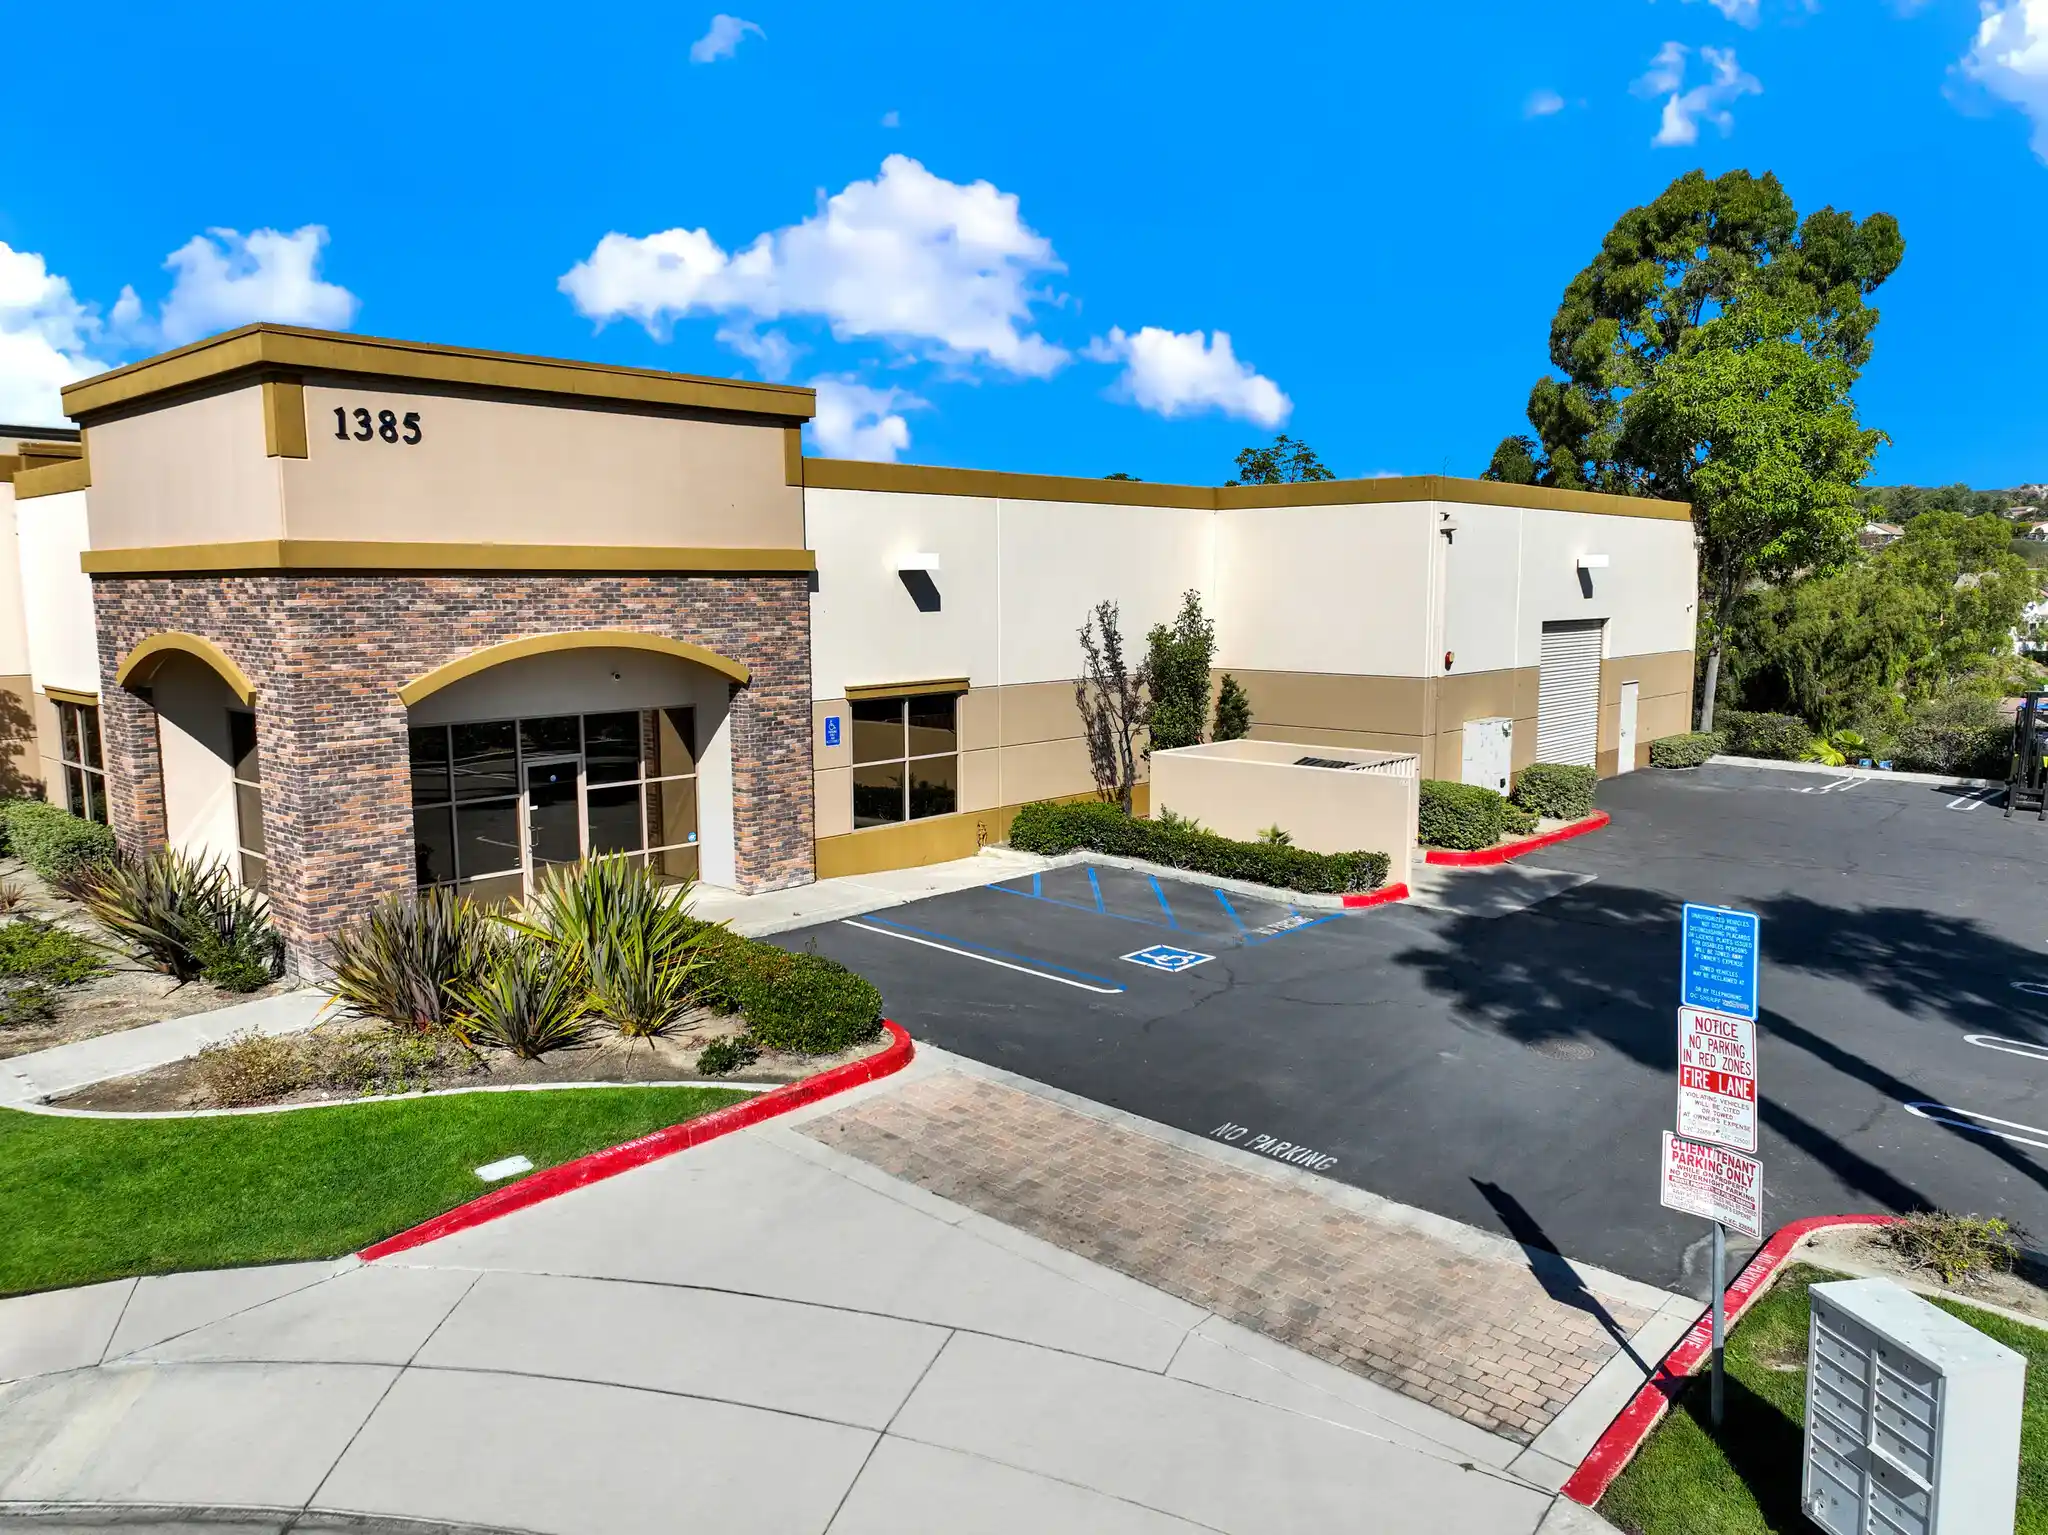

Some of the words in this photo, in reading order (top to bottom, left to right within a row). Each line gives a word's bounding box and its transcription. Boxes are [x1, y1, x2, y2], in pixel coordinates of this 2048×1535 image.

[333, 406, 422, 445] 1385
[1726, 918, 1750, 928] VEHICLES
[1696, 933, 1714, 942] LICENSE
[1716, 936, 1734, 945] PLATES
[1726, 932, 1751, 942] PLACARDS
[1725, 946, 1748, 954] PERSONS
[1716, 968, 1739, 978] VEHICLES
[1695, 1016, 1738, 1038] NOTICE
[1689, 1034, 1702, 1050] NO
[1708, 1038, 1746, 1060] PARKING
[1684, 1048, 1692, 1063] IN
[1698, 1052, 1716, 1068] RED
[1722, 1056, 1752, 1076] ZONES
[1684, 1066, 1710, 1090] FIRE
[1718, 1073, 1752, 1100] LANE
[1686, 1091, 1718, 1103] VIOLATING
[1720, 1098, 1750, 1110] VEHICLES
[1694, 1100, 1709, 1108] WILL
[1722, 1106, 1740, 1116] CITED
[1713, 1110, 1734, 1120] TOWED
[1724, 1120, 1752, 1132] EXPENSE
[615, 1131, 666, 1152] PARKING
[1210, 1122, 1248, 1140] NO
[1244, 1134, 1338, 1170] PARKING
[1672, 1150, 1723, 1176] PARKING
[1726, 1167, 1754, 1188] ONLY
[1676, 1164, 1700, 1174] WHILE
[1702, 1170, 1714, 1178] ON
[1714, 1174, 1749, 1194] PROPERTY
[1670, 1168, 1680, 1176] NO
[1683, 1172, 1724, 1189] OVERNIGHT
[1726, 1185, 1755, 1202] PARKING
[1731, 1263, 1767, 1293] PARKING
